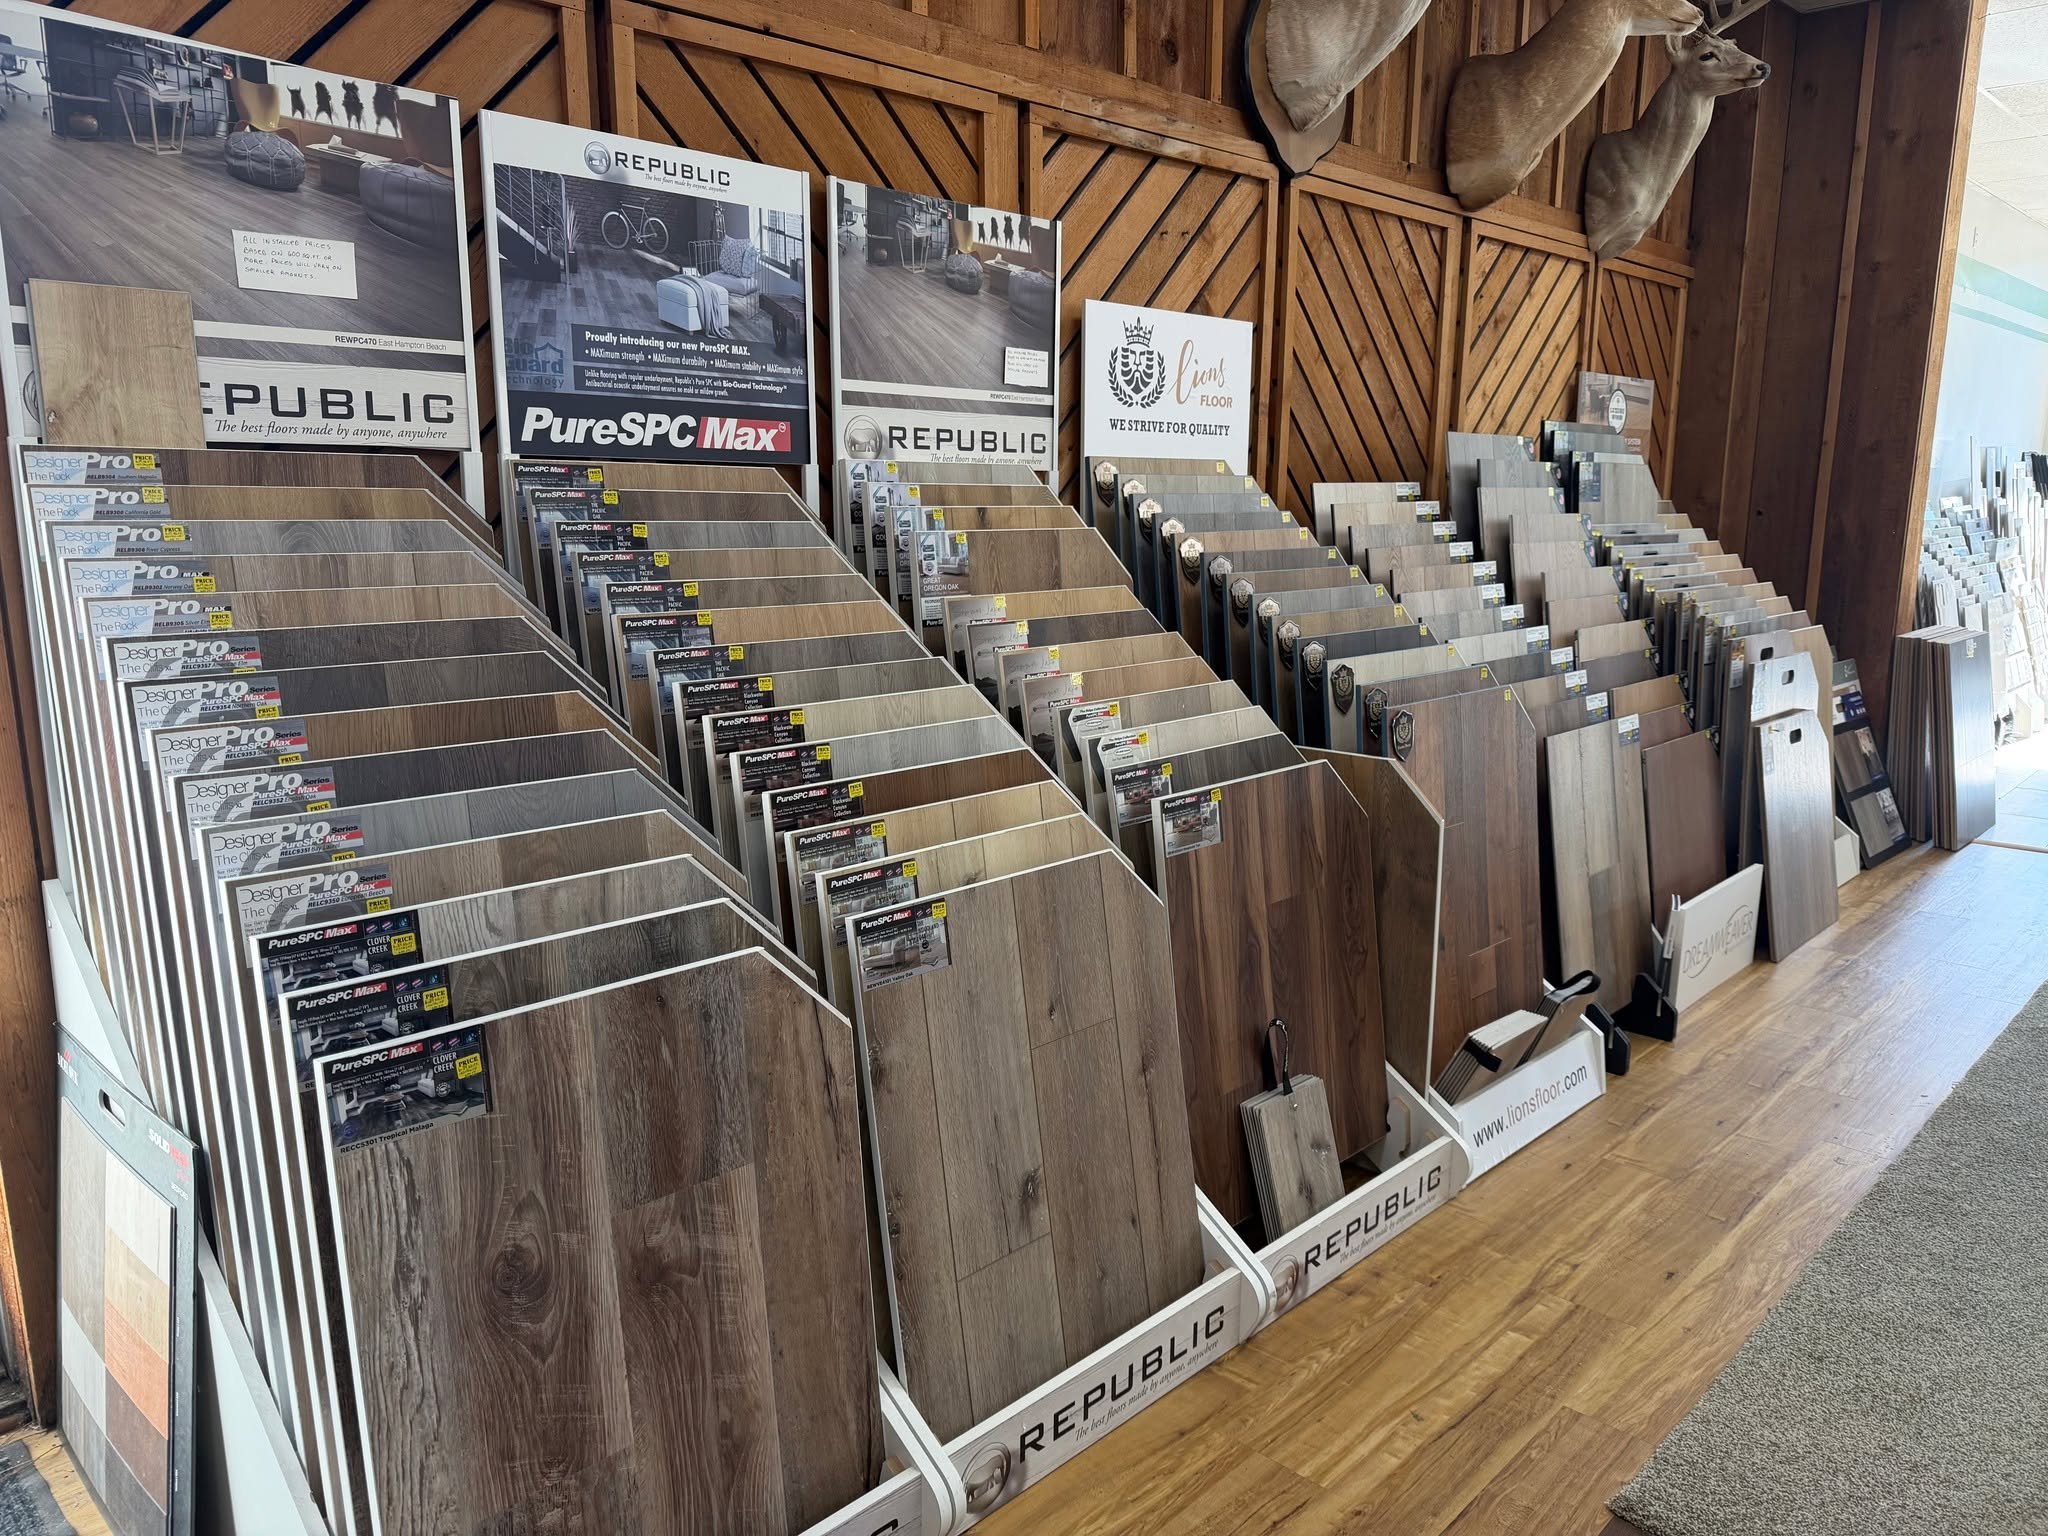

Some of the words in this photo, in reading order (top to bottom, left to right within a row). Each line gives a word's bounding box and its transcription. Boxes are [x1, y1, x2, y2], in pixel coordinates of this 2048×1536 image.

[614, 151, 730, 186] REPUBLIC
[708, 184, 727, 193] anywhere
[243, 236, 256, 244] ALL
[244, 247, 266, 256] BASED
[245, 267, 275, 275] SMALLER
[335, 335, 377, 346] REWPC470
[378, 338, 393, 347] East
[394, 339, 425, 350] Hampton
[426, 341, 446, 351] Beach
[585, 331, 618, 346] Proudly
[620, 334, 664, 350] introducing
[682, 343, 698, 351] new
[700, 342, 729, 354] PureSPC
[732, 345, 750, 356] MAX.
[590, 348, 620, 359] MAXimum
[622, 350, 644, 363] strength
[653, 353, 680, 364] MAXimum
[682, 356, 708, 368] durability
[715, 359, 740, 370] MAXimum
[742, 362, 761, 373] stability
[767, 364, 791, 374] MAXimum
[792, 366, 803, 376] style
[585, 380, 613, 388] Antibacterial
[632, 383, 660, 392] underlayment
[700, 387, 714, 395] mildew
[600, 370, 617, 380] flooring
[628, 373, 643, 381] regular
[722, 380, 751, 390] Bio-Guard
[200, 382, 454, 424] PUBLIC
[1200, 394, 1233, 408] FLOOR
[214, 419, 237, 433] The
[240, 422, 263, 434] best
[266, 421, 298, 436] floors
[301, 424, 334, 436] made
[336, 424, 350, 440] by
[352, 428, 394, 440] anyone,
[397, 426, 448, 440] anywhere
[521, 406, 696, 448] PureSPC
[1110, 418, 1126, 431] WE
[1128, 419, 1165, 433] STRIVE
[1166, 422, 1187, 434] FOR
[1189, 423, 1230, 436] QUALITY
[888, 426, 1047, 454] REPUBLIC
[27, 455, 83, 470] Designer
[86, 452, 131, 469] Pro
[930, 453, 940, 462] The
[942, 454, 954, 462] best
[955, 454, 970, 463] floors
[971, 455, 986, 464] made
[35, 492, 91, 506] Designer
[95, 488, 140, 504] Pro
[56, 530, 113, 545] Designer
[117, 526, 161, 542] Pro
[74, 568, 130, 582] Designer
[134, 563, 179, 578] Pro
[776, 792, 808, 803] PureSPC
[213, 833, 277, 851] Designer
[281, 821, 331, 836] Pro
[332, 825, 358, 833] Series
[240, 883, 304, 903] Designer
[308, 872, 358, 887] Pro
[359, 874, 387, 883] Series
[308, 897, 340, 908] RELC9350
[341, 893, 368, 902] European
[369, 899, 389, 907] PRICE
[242, 907, 265, 920] The
[268, 904, 289, 917] Cliffs
[861, 916, 892, 930] PureSPC
[268, 930, 323, 950] PureSPC
[325, 924, 352, 938] Max
[367, 936, 390, 945] CLOVER
[393, 936, 413, 945] PRICE
[1682, 910, 1753, 974] DREAMWEAVER
[368, 944, 388, 954] CREEK
[297, 990, 352, 1010] PureSPC
[355, 983, 382, 996] Max
[397, 993, 421, 1004] CLOVER
[425, 990, 445, 999] PRICE
[398, 1002, 418, 1013] CREEK
[332, 1051, 388, 1074] PureSPC
[390, 1045, 417, 1059] Max
[433, 1052, 457, 1064] CLOVER
[458, 1056, 478, 1068] PRICE
[434, 1063, 454, 1074] CREEK
[1473, 1065, 1587, 1148] www.lionsfloor.com
[379, 1130, 408, 1143] Tropical
[409, 1122, 434, 1135] Malaga
[1304, 1166, 1441, 1275] REPUBLIC
[1020, 1305, 1224, 1464] REPUBLIC
[1076, 1427, 1088, 1442] The
[1090, 1415, 1106, 1432] best
[1106, 1400, 1128, 1426] floors
[1128, 1388, 1148, 1404] made
[1149, 1378, 1159, 1394] by
[1159, 1364, 1185, 1386] anyone,
[1188, 1340, 1218, 1367] anywhere
